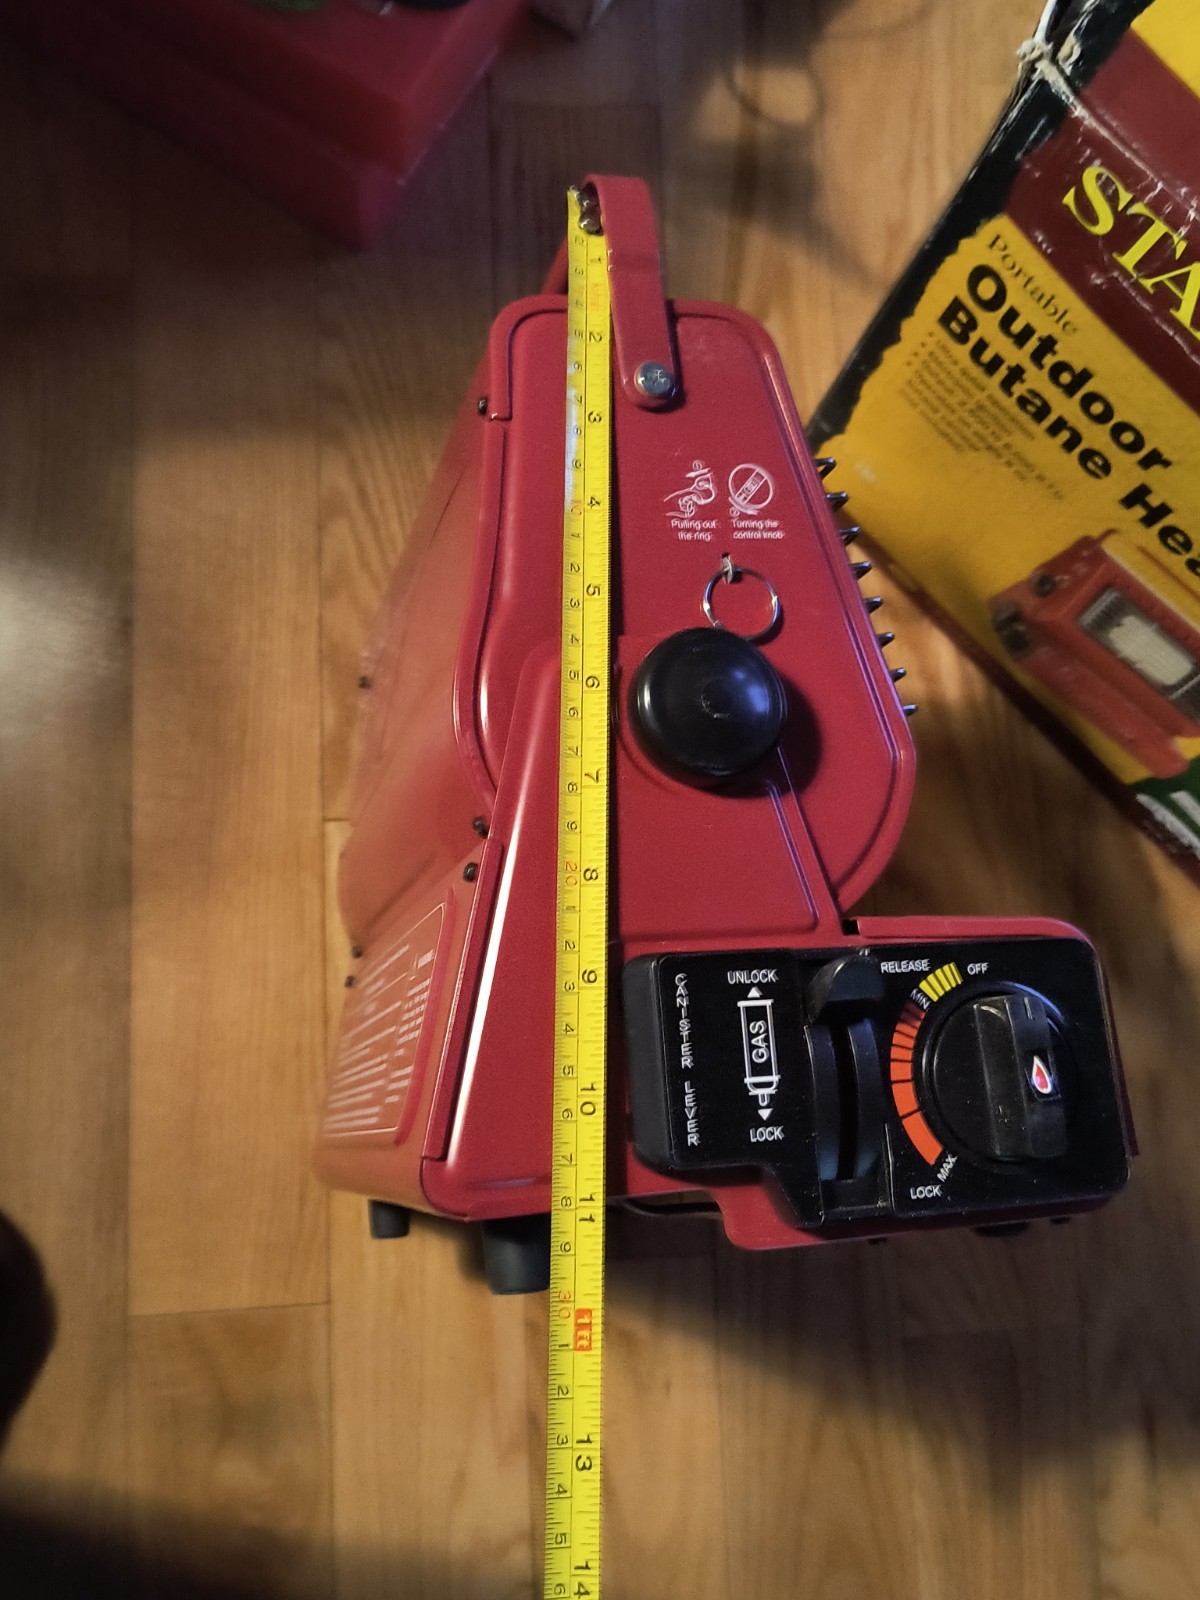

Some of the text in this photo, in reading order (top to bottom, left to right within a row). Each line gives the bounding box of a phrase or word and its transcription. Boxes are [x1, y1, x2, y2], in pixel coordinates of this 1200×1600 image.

[985, 233, 1079, 338] Portable
[589, 331, 602, 342] 2
[574, 361, 582, 371] 6
[966, 264, 1173, 471] Outdoor
[938, 296, 1113, 481] Butane
[573, 395, 582, 405] 7
[588, 410, 602, 423] 3
[573, 426, 582, 436] 8
[572, 459, 582, 469] 9
[587, 496, 601, 509] 4
[671, 519, 717, 530] Pulling out
[731, 519, 779, 530] Turning the
[678, 531, 712, 542] the ring
[733, 531, 784, 540] control knob
[570, 562, 580, 573] 2
[586, 583, 600, 597] 5
[569, 598, 580, 609] 3
[570, 634, 579, 644] 4
[569, 670, 579, 681] 5
[585, 676, 600, 689] 6
[568, 706, 578, 718] 6
[567, 746, 578, 757] 7
[584, 768, 599, 783] 7
[567, 782, 578, 793] 8
[567, 821, 578, 831] 9
[565, 861, 577, 887] 20
[583, 867, 598, 882] 8
[564, 939, 576, 951] 2
[880, 958, 932, 975] RELEASE
[967, 962, 990, 977] OFF
[582, 969, 597, 984] 9
[727, 968, 779, 985] UNLOCK
[564, 981, 575, 992] 3
[910, 987, 932, 1010] MIN
[563, 1023, 574, 1035] 4
[750, 1019, 769, 1064] GAS
[675, 973, 700, 1147] CANISTER LEVER
[562, 1065, 574, 1076] 5
[580, 1082, 596, 1116] 10
[562, 1108, 573, 1119] 6
[749, 1126, 784, 1143] LOCK
[561, 1153, 572, 1164] 7
[937, 1153, 959, 1184] MAX
[910, 1184, 943, 1200] LOCK
[560, 1196, 572, 1207] 8
[579, 1194, 596, 1222] 11
[560, 1242, 571, 1253] 9
[558, 1290, 571, 1319] 30
[557, 1385, 569, 1396] 2
[556, 1434, 568, 1446] 3
[575, 1434, 593, 1472] 13
[556, 1483, 567, 1496] 4
[555, 1532, 567, 1545] 5
[574, 1561, 591, 1599] 14
[554, 1583, 565, 1595] 6
